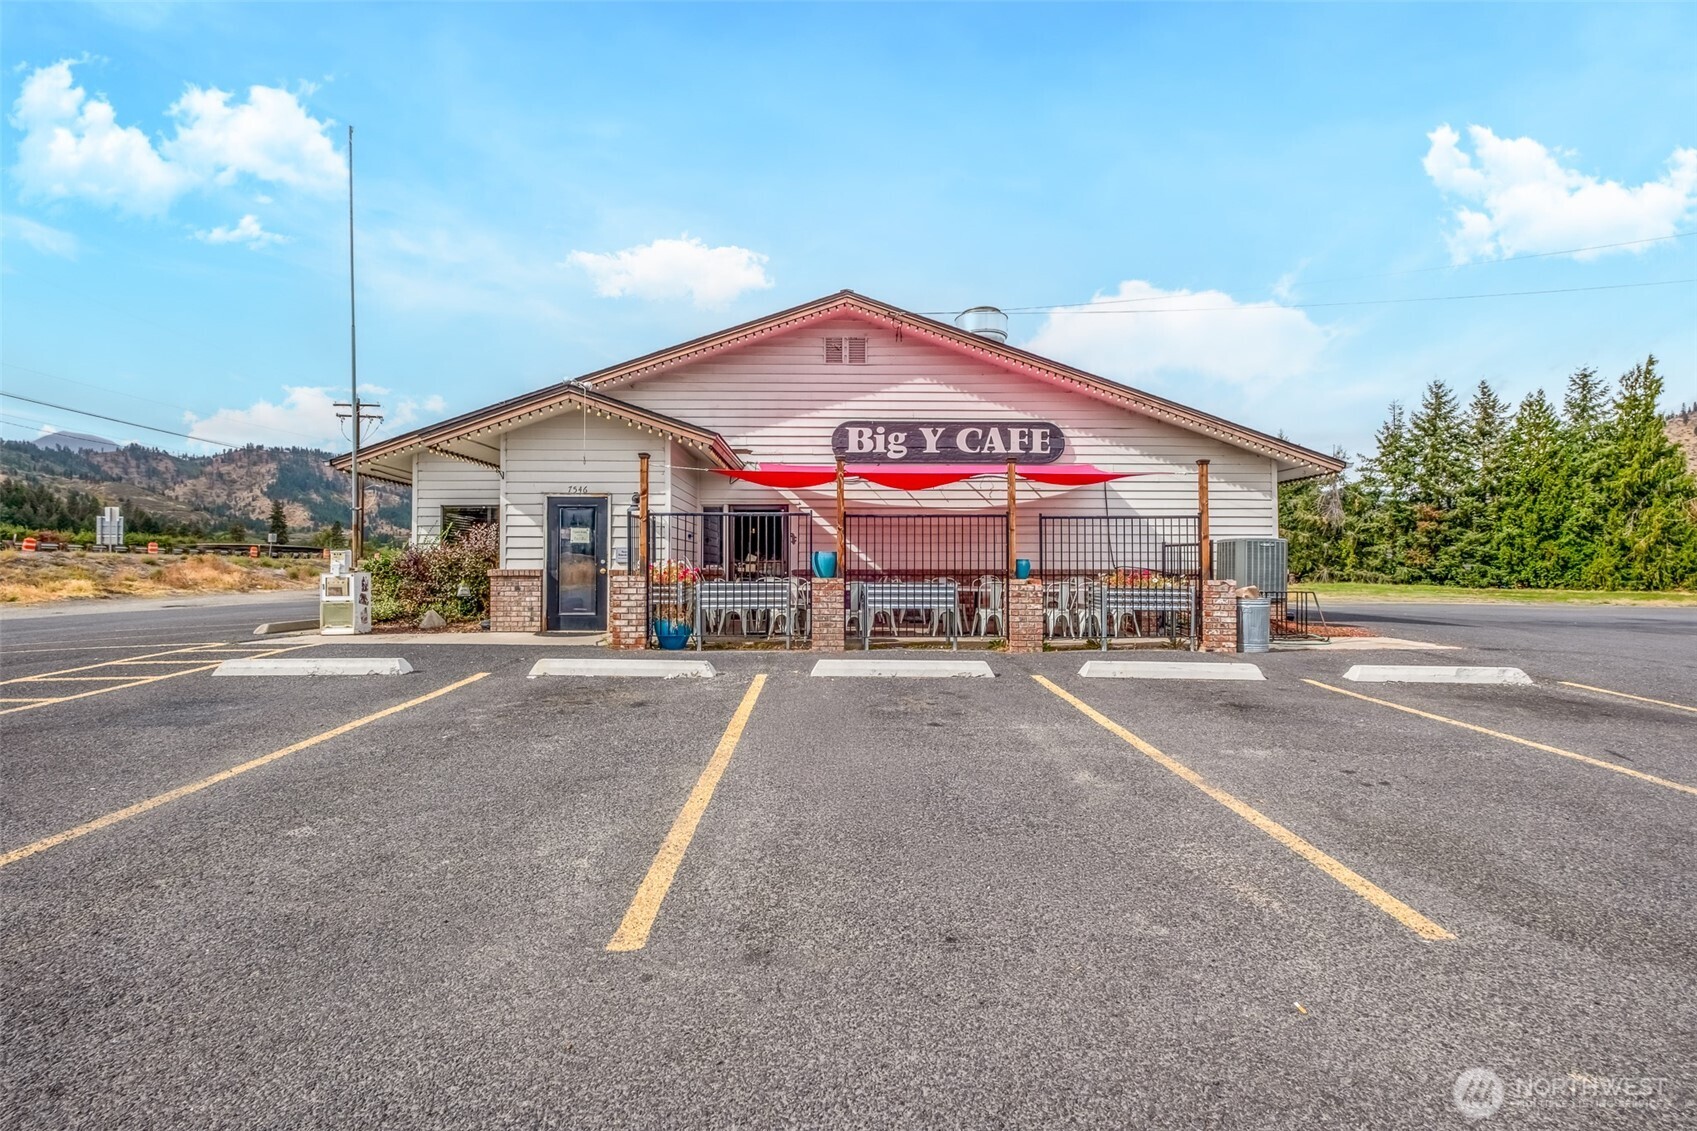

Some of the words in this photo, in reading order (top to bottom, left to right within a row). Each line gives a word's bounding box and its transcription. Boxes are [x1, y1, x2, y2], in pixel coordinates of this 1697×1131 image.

[845, 426, 908, 459] Big
[919, 427, 946, 453] Y
[956, 427, 1051, 454] CAFE
[568, 485, 588, 494] 7546
